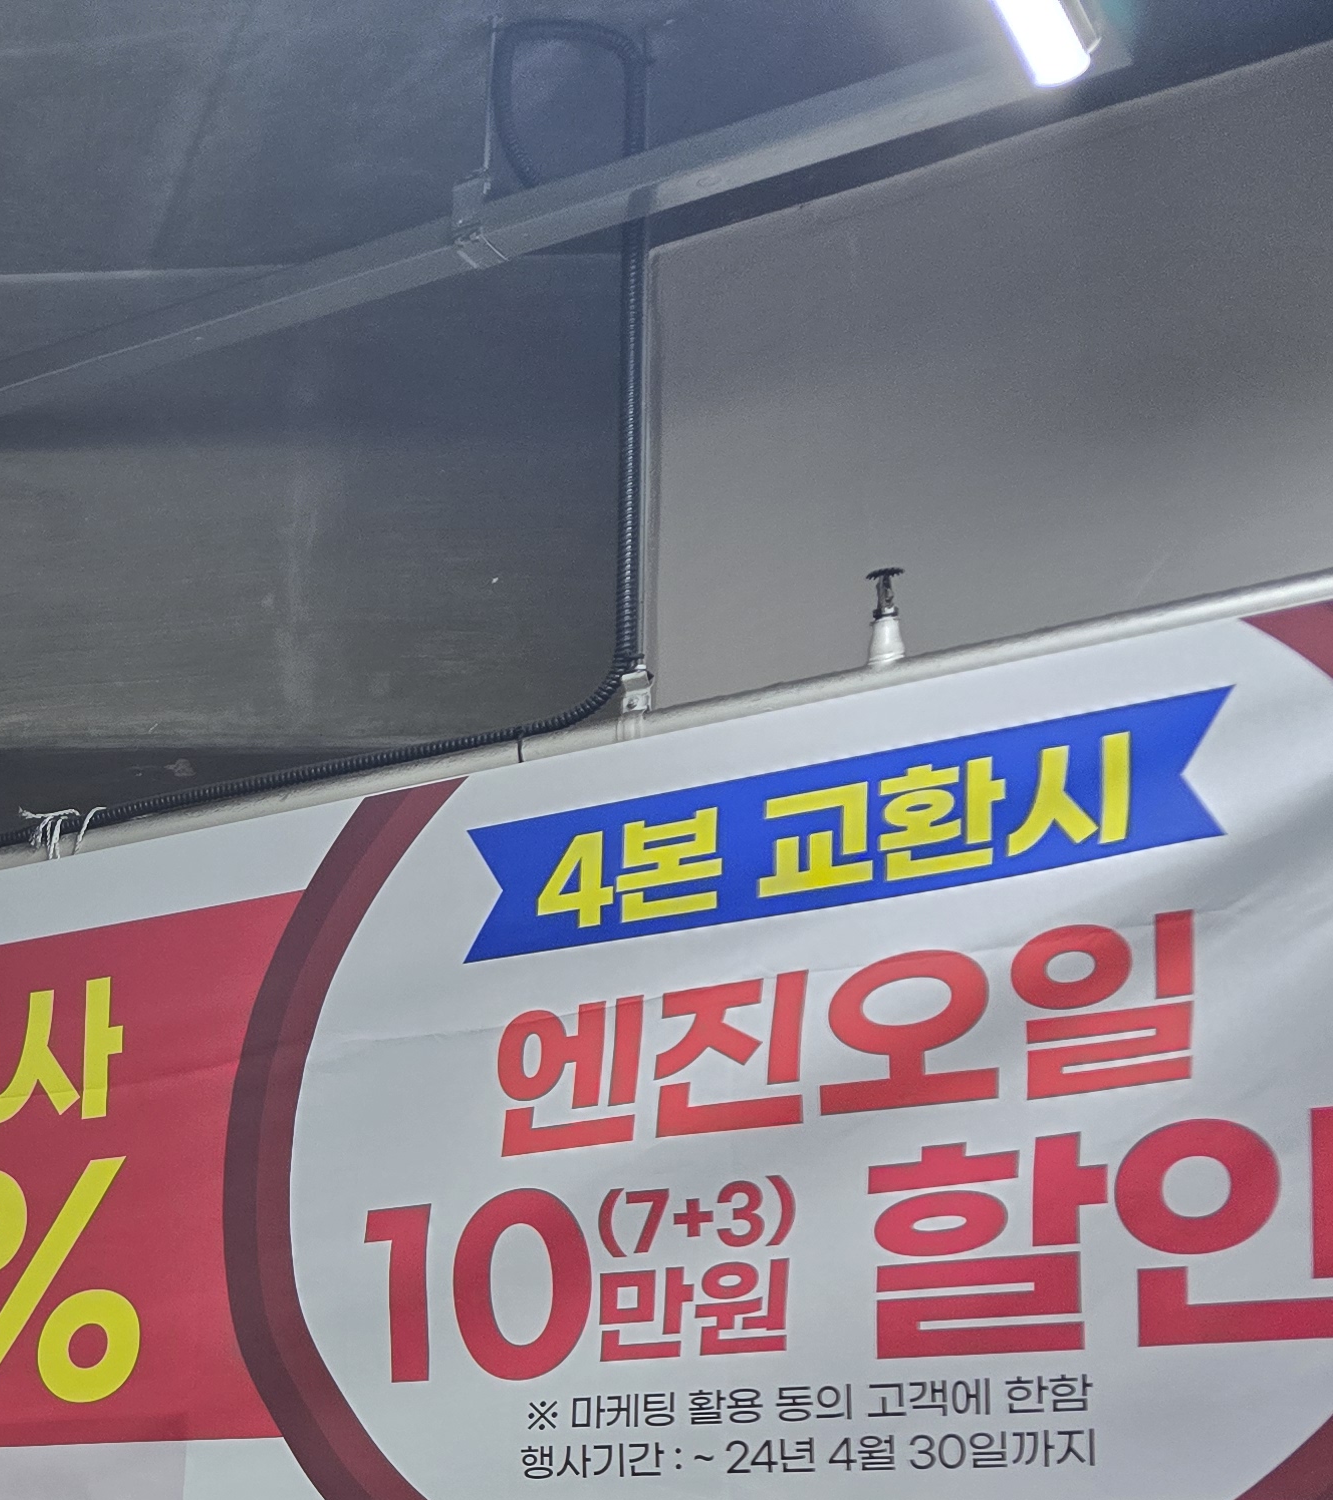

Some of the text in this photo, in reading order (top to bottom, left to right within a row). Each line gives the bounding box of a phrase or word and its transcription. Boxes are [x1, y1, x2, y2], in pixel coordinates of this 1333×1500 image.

[537, 731, 1132, 930] 4본 교환시
[496, 908, 1195, 1158] 엔진오일
[596, 1173, 797, 1258] (7+3)
[866, 1105, 1333, 1360] 할인
[569, 1393, 677, 1430] 마케팅
[687, 1388, 764, 1425] 활용
[774, 1384, 854, 1423] 동의
[866, 1376, 992, 1419] 고객에
[1004, 1373, 1093, 1415] 한함
[725, 1435, 816, 1476] 24년
[827, 1433, 897, 1473] 4월
[908, 1428, 1098, 1471] 30일까지
